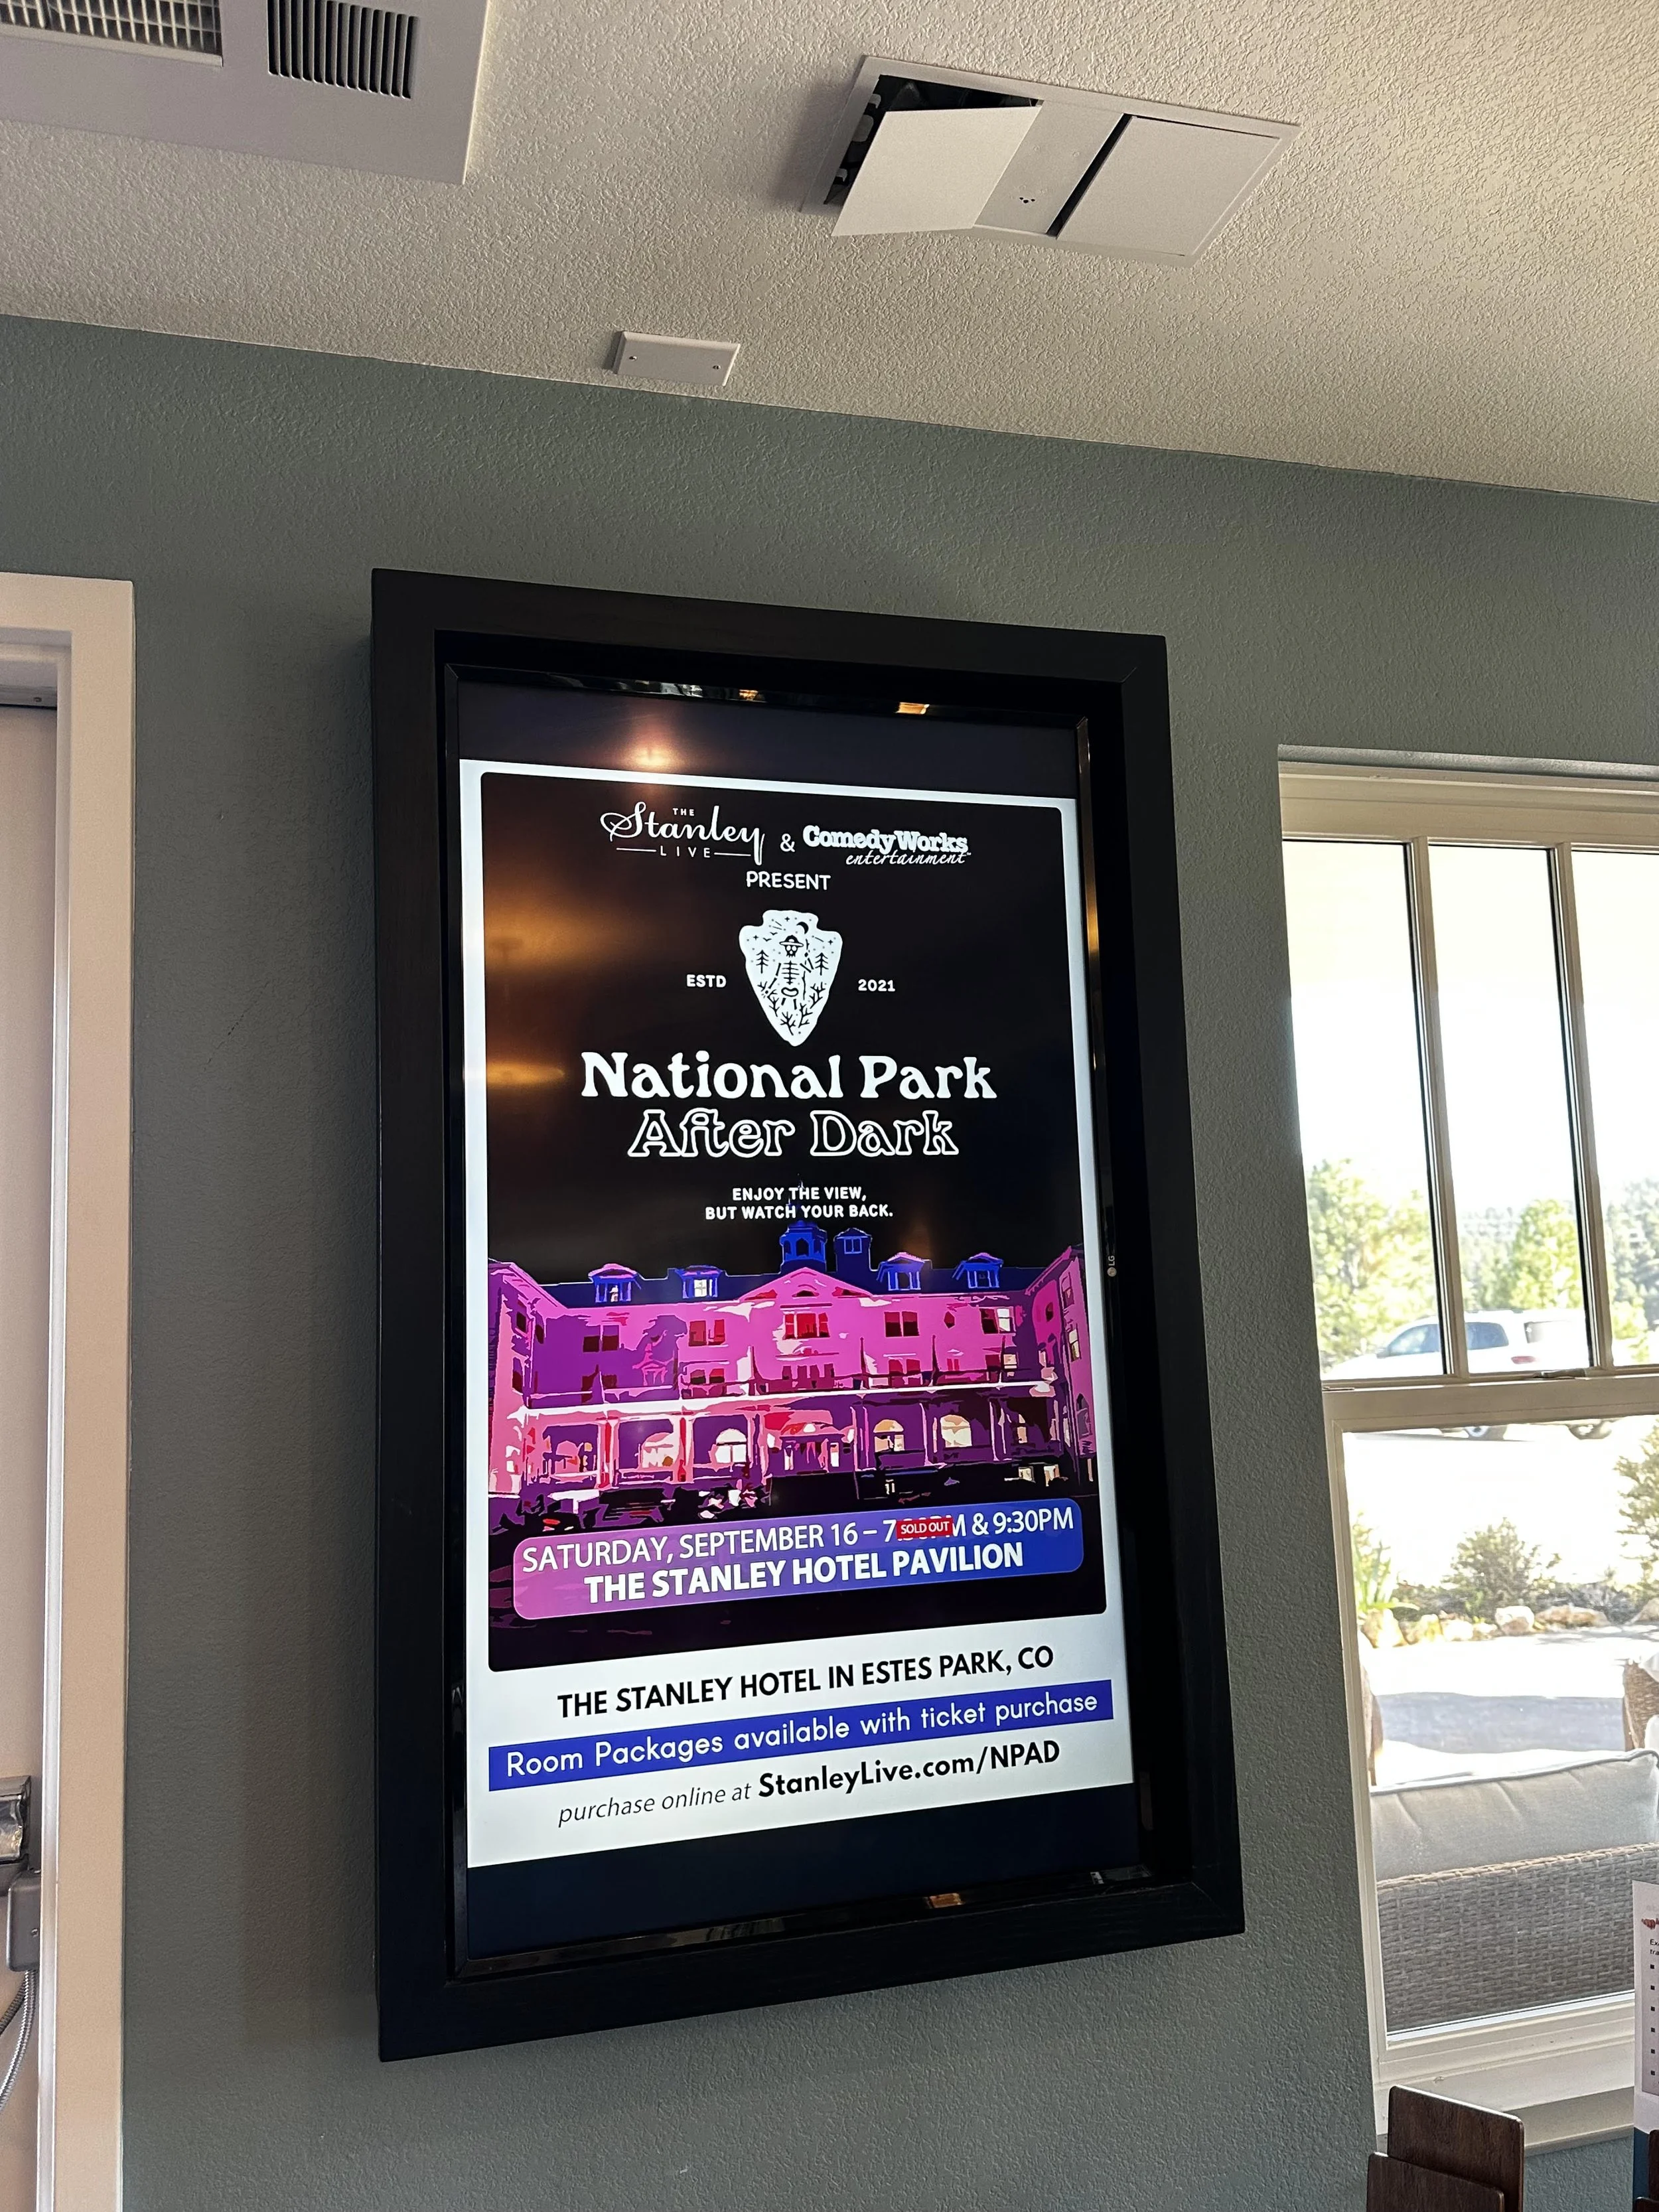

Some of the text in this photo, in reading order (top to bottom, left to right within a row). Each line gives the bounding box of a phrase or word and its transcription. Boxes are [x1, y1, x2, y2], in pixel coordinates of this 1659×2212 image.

[672, 808, 695, 816] THE
[600, 801, 765, 866] Stanley
[780, 833, 796, 853] &
[660, 846, 711, 858] LIVE
[845, 849, 967, 865] entertainment
[746, 871, 831, 891] PRESENT
[686, 974, 727, 988] ESTD
[858, 979, 896, 992] 2021
[581, 1050, 997, 1100] National Park
[627, 1107, 960, 1158] After Dark
[733, 1186, 867, 1202] ENJOY THE VIEW,
[705, 1204, 893, 1220] BUT WATCH YOUR BACK.
[1108, 1255, 1116, 1266] LG
[901, 1521, 950, 1534] SOLD OUT
[522, 1536, 674, 1572] SATURDAY,
[679, 1525, 824, 1559] SEPTEMBER
[830, 1522, 858, 1546] 16
[972, 1512, 989, 1536] &
[993, 1507, 1074, 1534] 9:30PM
[583, 1542, 1023, 1603] THE STANLEY HOTEL PAVILION
[557, 1645, 1054, 1718] THE STANLEY HOTEL IN ESTES PARK, CO
[506, 1692, 1098, 1777] Room Packages available with ticket purchase
[558, 1740, 1060, 1828] purchase online at StanleyLive.com/NPAD
